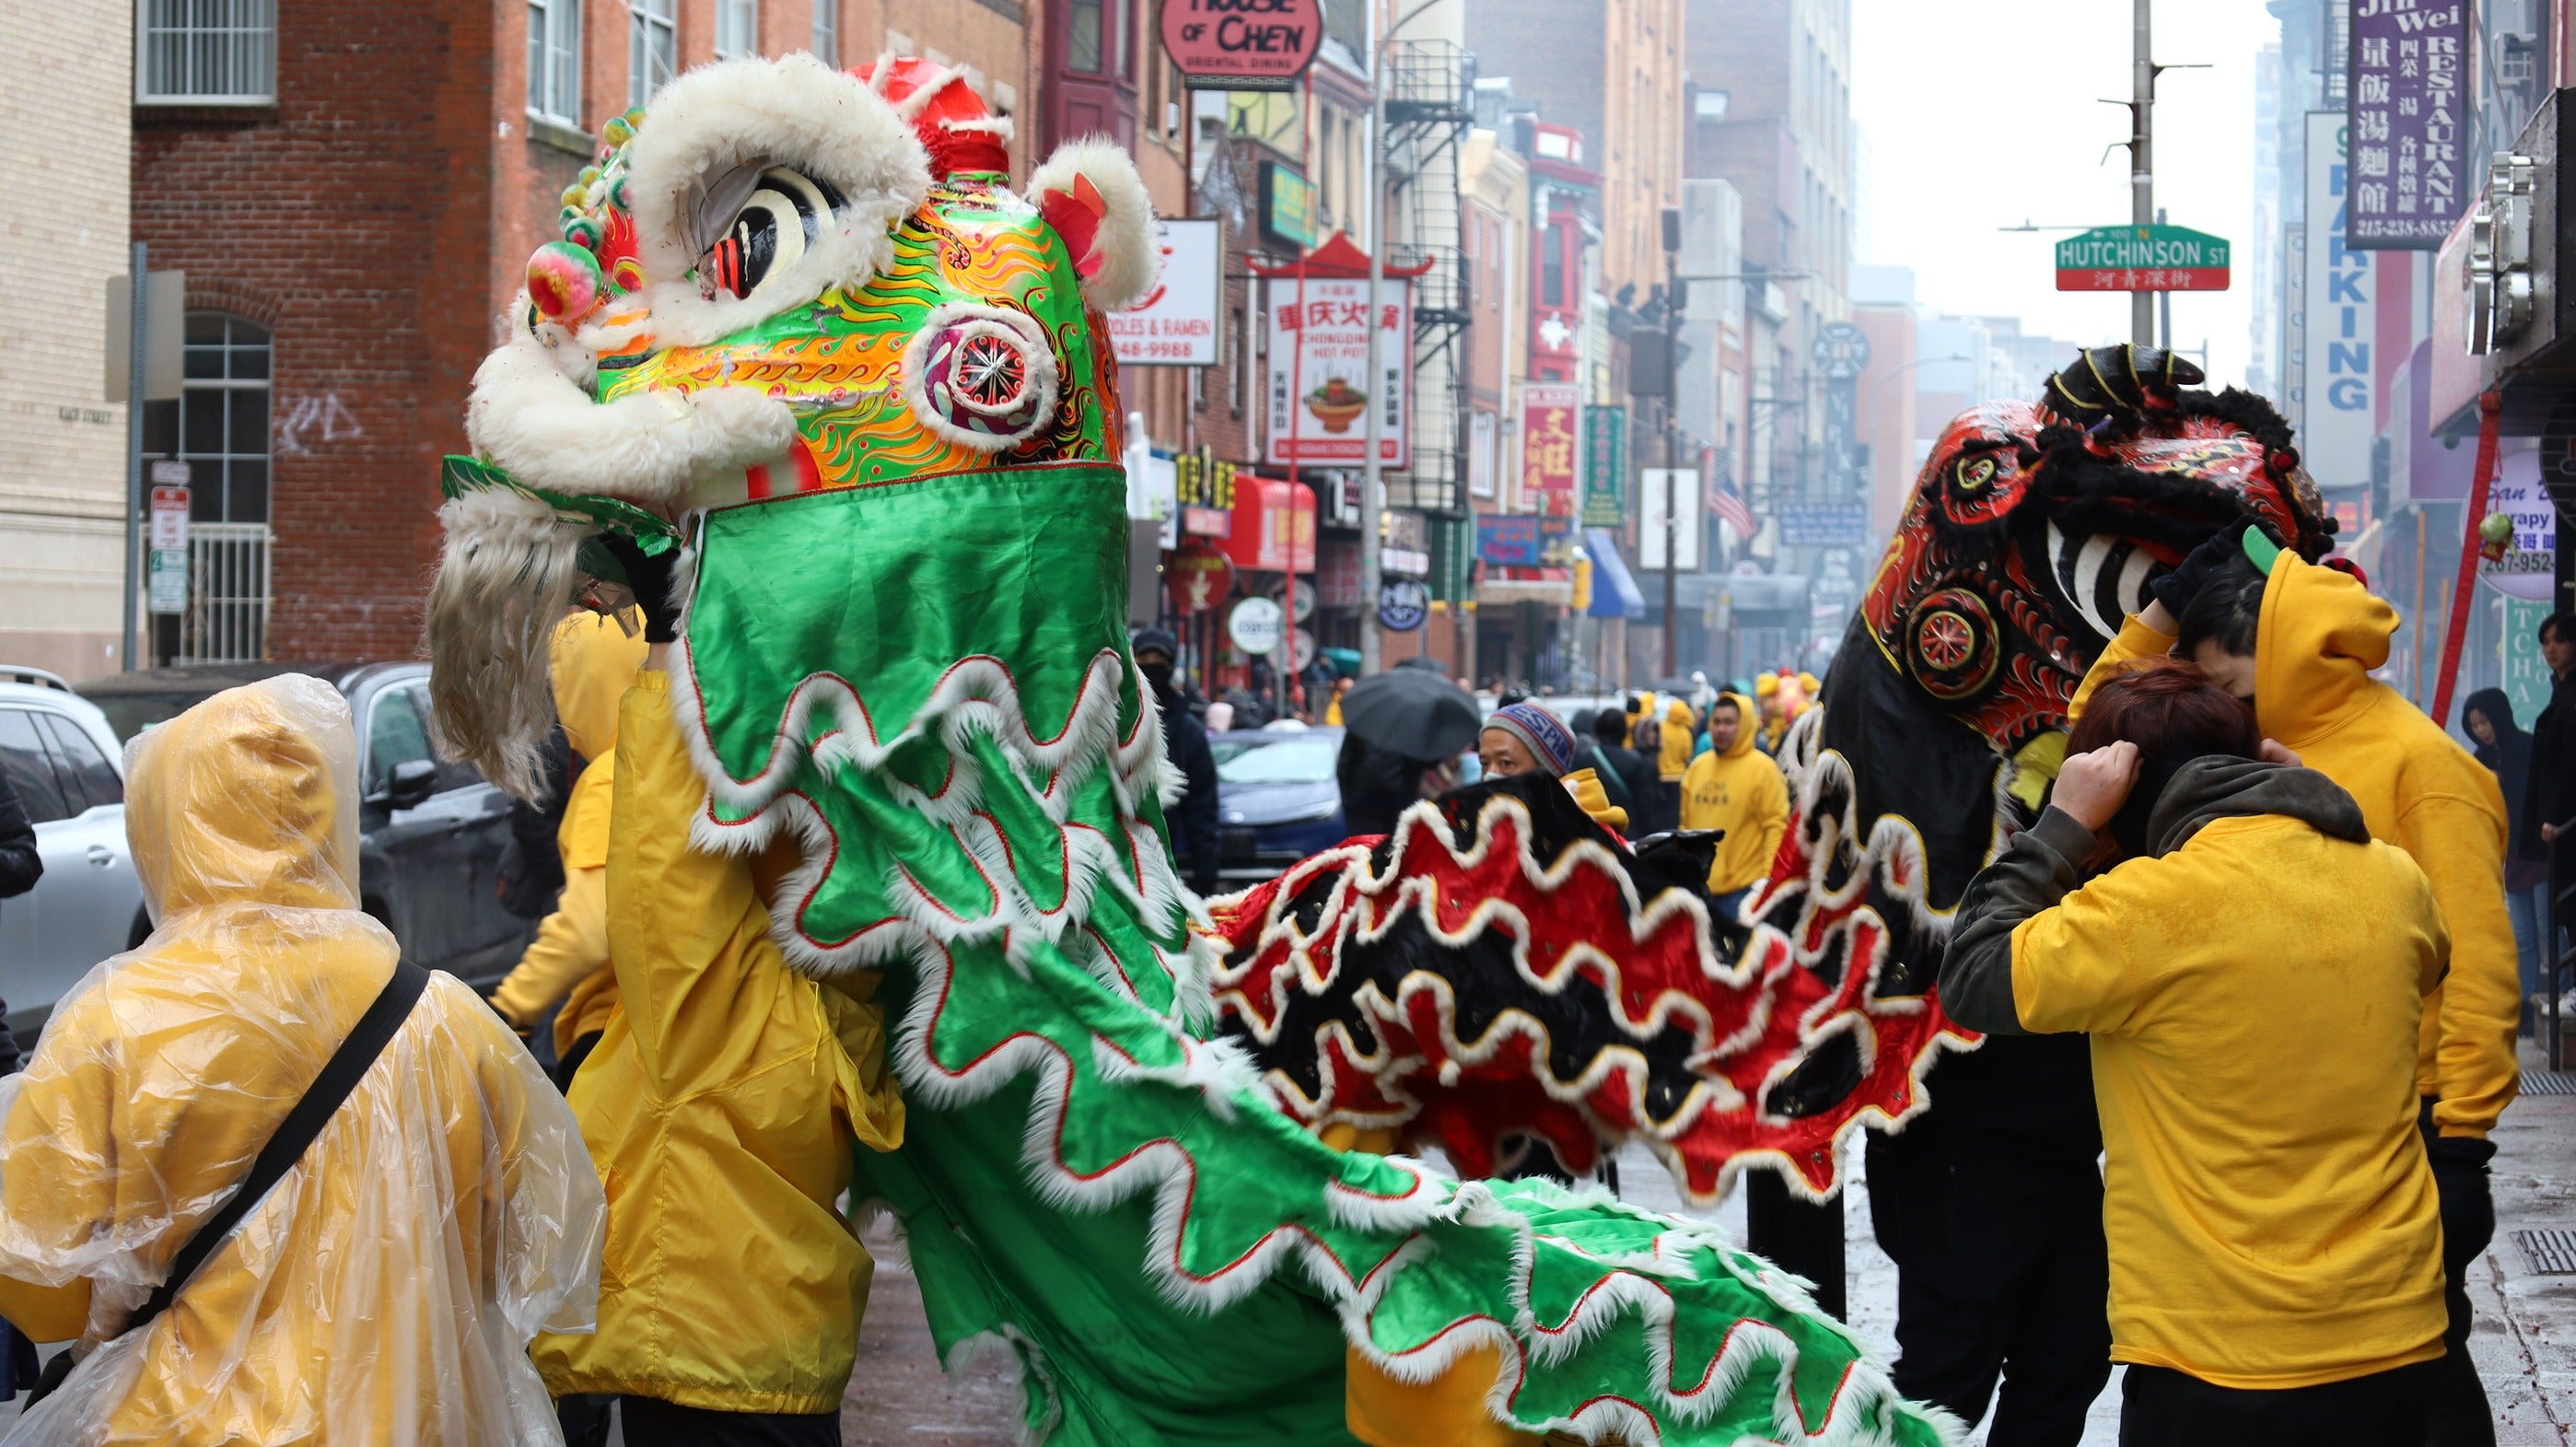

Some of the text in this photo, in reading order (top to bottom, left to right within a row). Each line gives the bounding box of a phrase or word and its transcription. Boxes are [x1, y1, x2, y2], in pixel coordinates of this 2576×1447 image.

[2394, 5, 2460, 33] Wei
[1183, 15, 1304, 53] OF CHEN
[1185, 56, 1292, 69] ORIENTAL DINING
[2424, 36, 2460, 214] RESTAURANT
[2137, 228, 2150, 240] N
[2059, 240, 2227, 267] HUTCHINSON ST
[1149, 318, 1159, 336] &
[1163, 318, 1212, 336] RAMEN
[1301, 333, 1370, 344] CHONGQIN
[1312, 347, 1335, 358] HOT
[2512, 601, 2532, 704] TCHA
